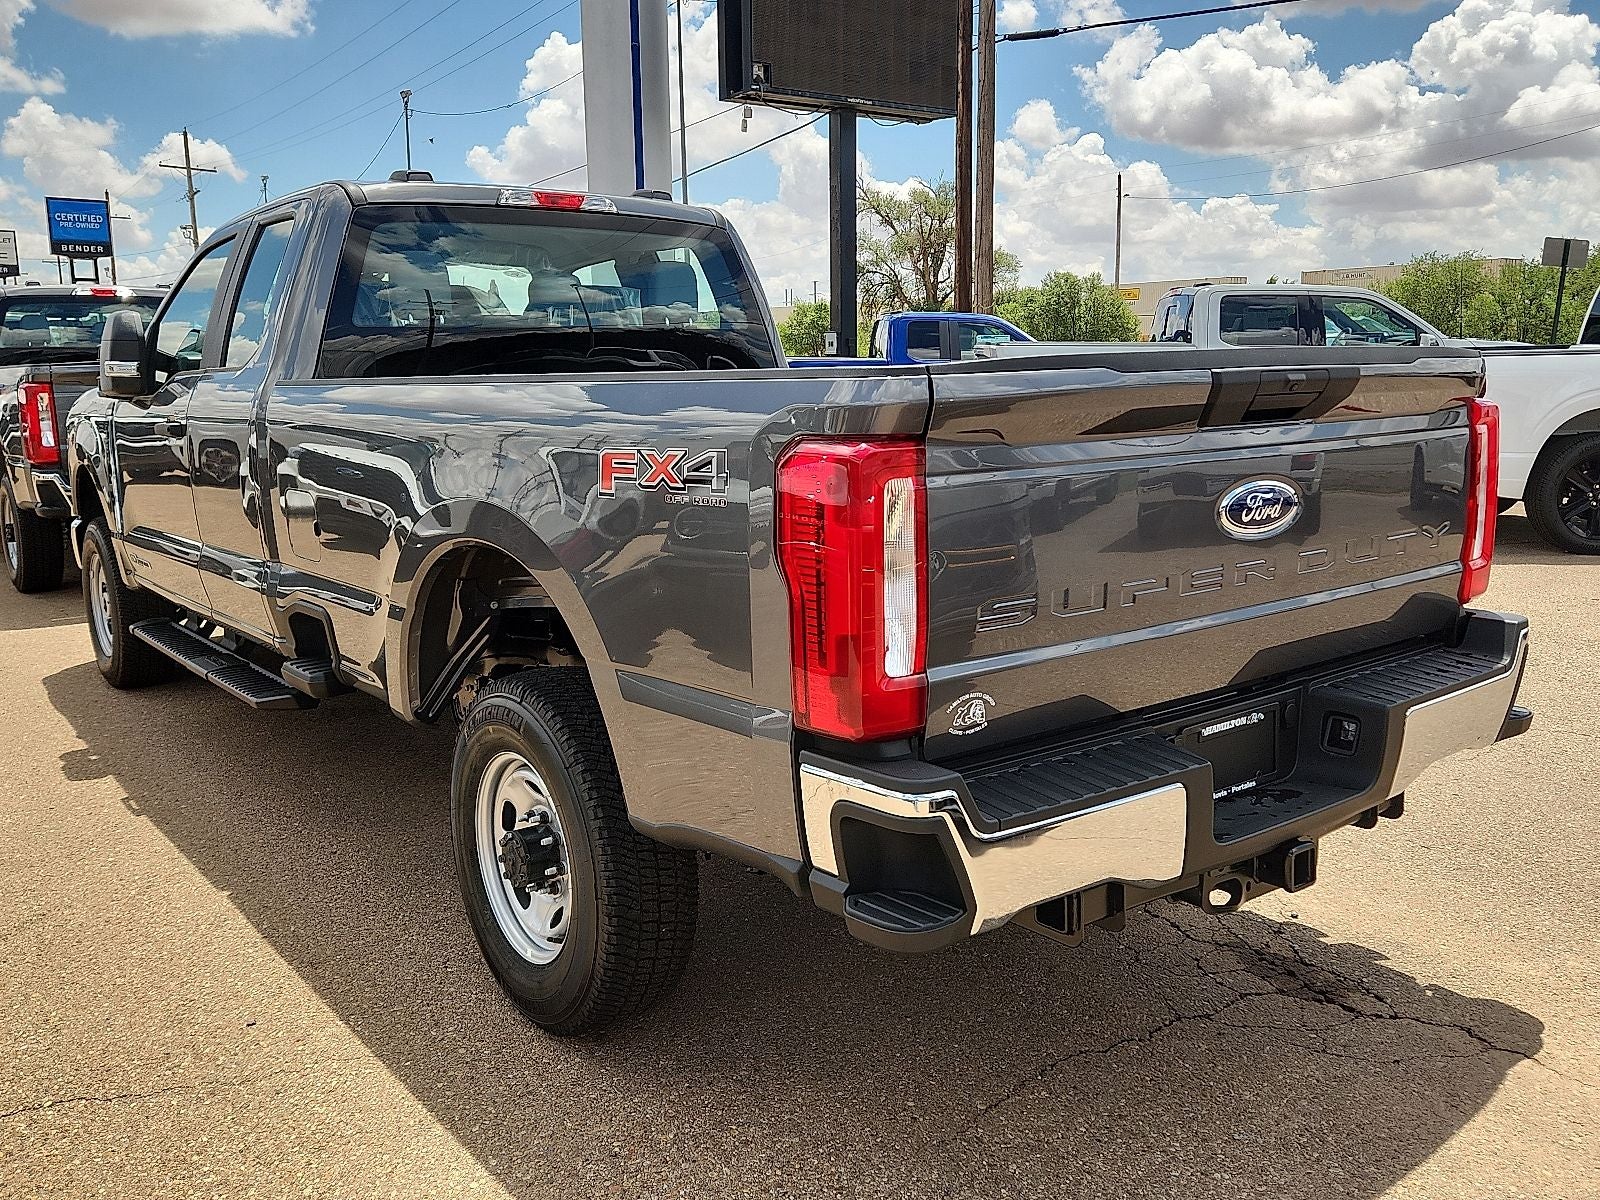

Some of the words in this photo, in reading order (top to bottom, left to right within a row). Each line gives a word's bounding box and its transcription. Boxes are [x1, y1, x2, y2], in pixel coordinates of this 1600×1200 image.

[54, 212, 103, 223] CERTIFIED
[59, 221, 100, 229] PRE-OWNED
[61, 244, 104, 253] BENDER
[597, 446, 730, 499] FX4
[664, 494, 690, 505] OFF
[692, 496, 728, 507] ROAD
[1241, 492, 1284, 523] Ford
[975, 559, 1276, 633] SUPER
[1297, 520, 1451, 575] DUTY
[1204, 716, 1247, 734] HAMILTON
[1231, 780, 1257, 793] Portales
